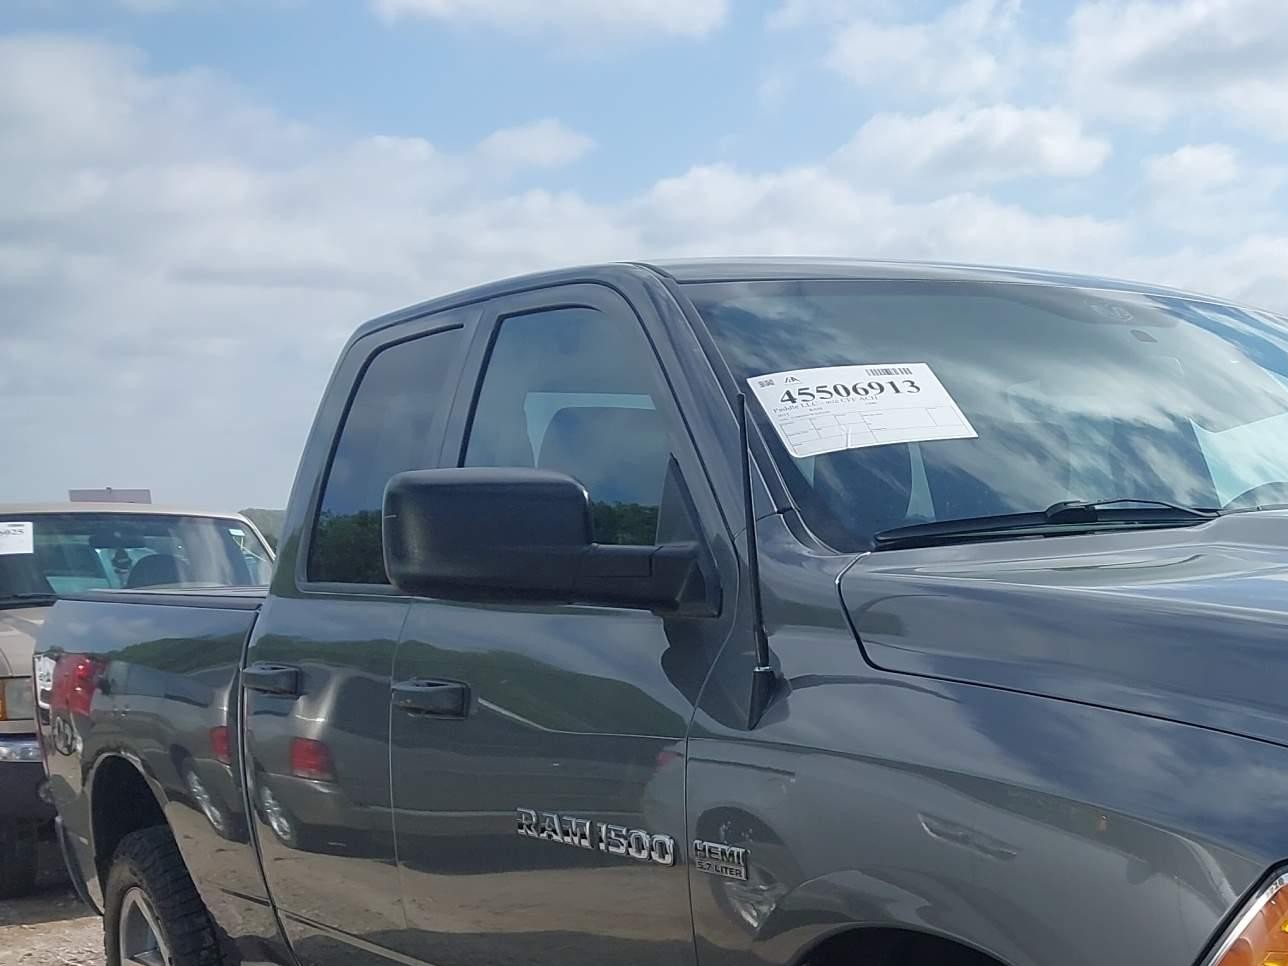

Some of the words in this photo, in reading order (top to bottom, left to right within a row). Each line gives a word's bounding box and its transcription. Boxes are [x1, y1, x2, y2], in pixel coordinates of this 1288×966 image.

[780, 380, 921, 404] 45506913
[516, 807, 594, 849] RAM
[597, 822, 675, 867] 1500
[693, 840, 746, 867] HEMI
[696, 860, 713, 871] 5.7
[714, 865, 743, 878] LITER
